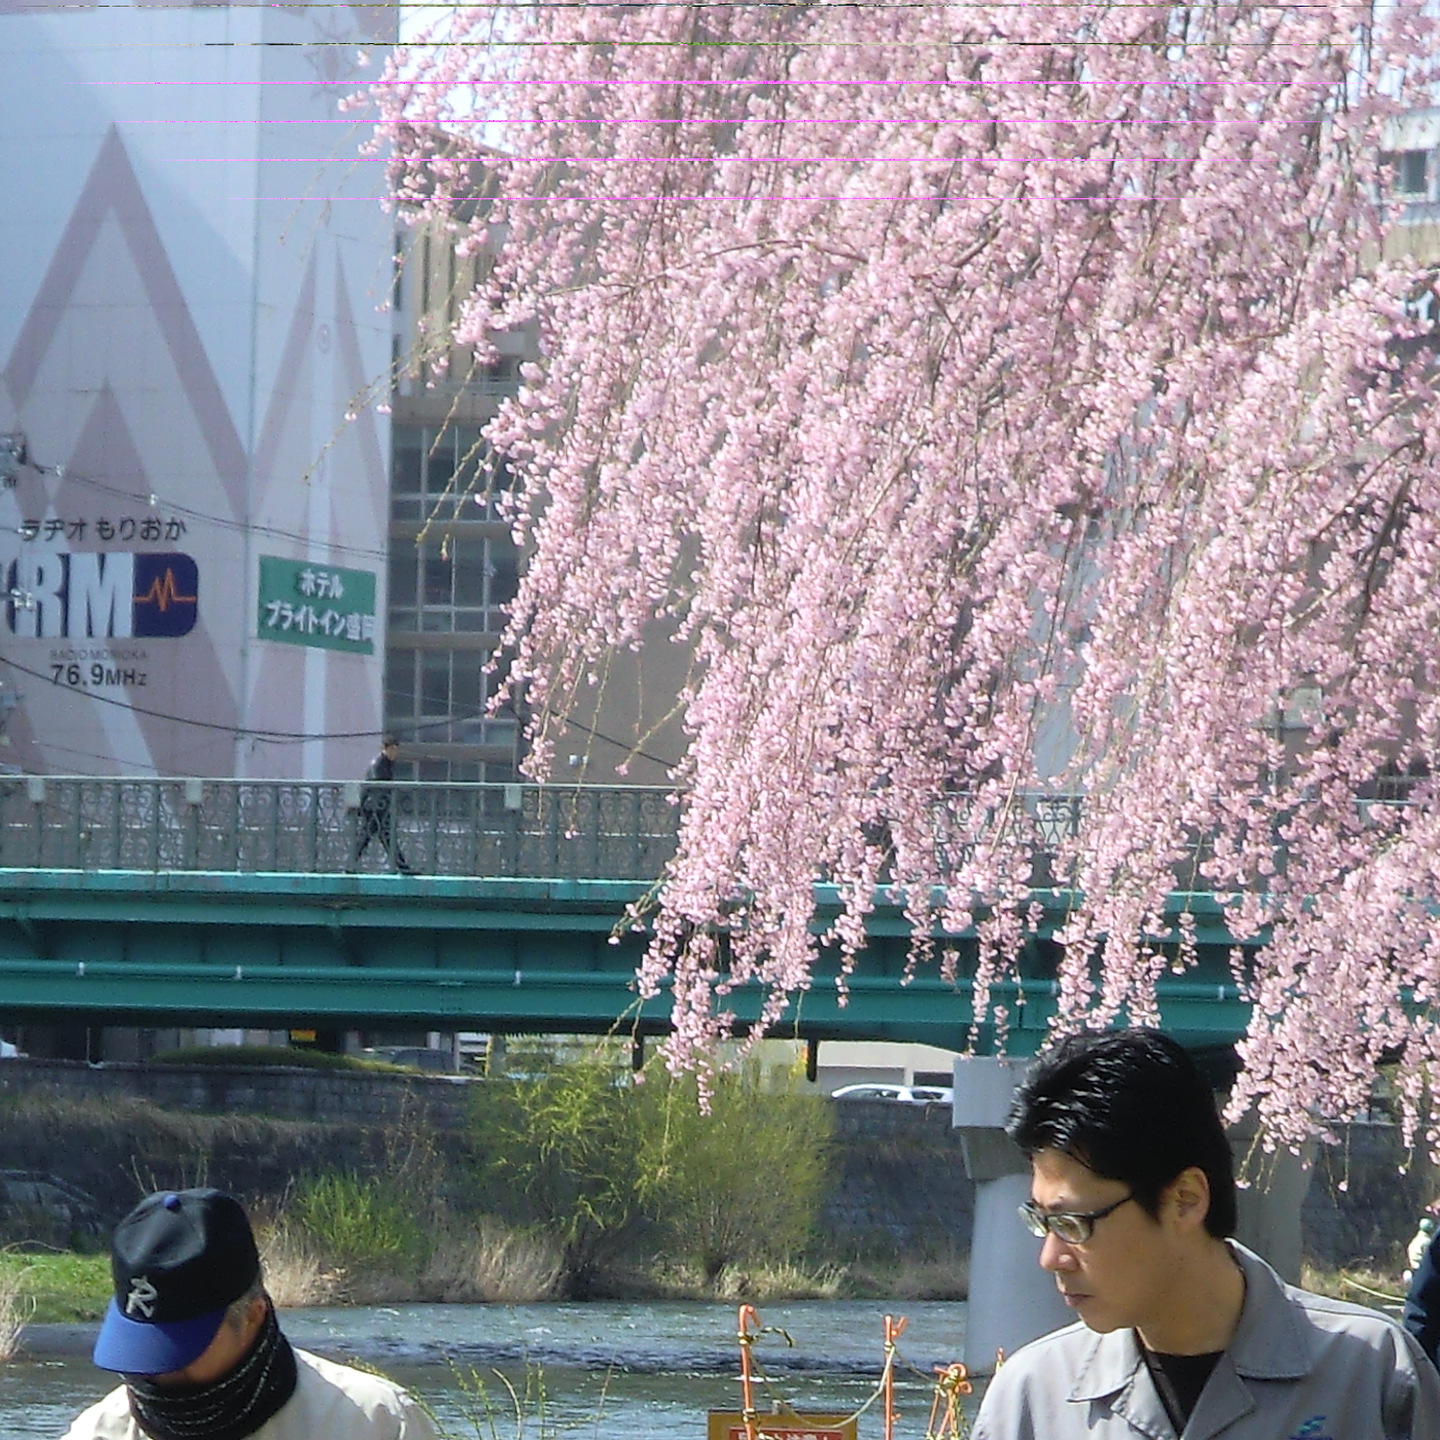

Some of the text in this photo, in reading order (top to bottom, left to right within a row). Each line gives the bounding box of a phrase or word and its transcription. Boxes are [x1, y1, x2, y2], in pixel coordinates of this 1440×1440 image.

[96, 517, 187, 541] もりおか
[301, 568, 344, 600] ホテル
[51, 663, 147, 686] 76.9MHz
